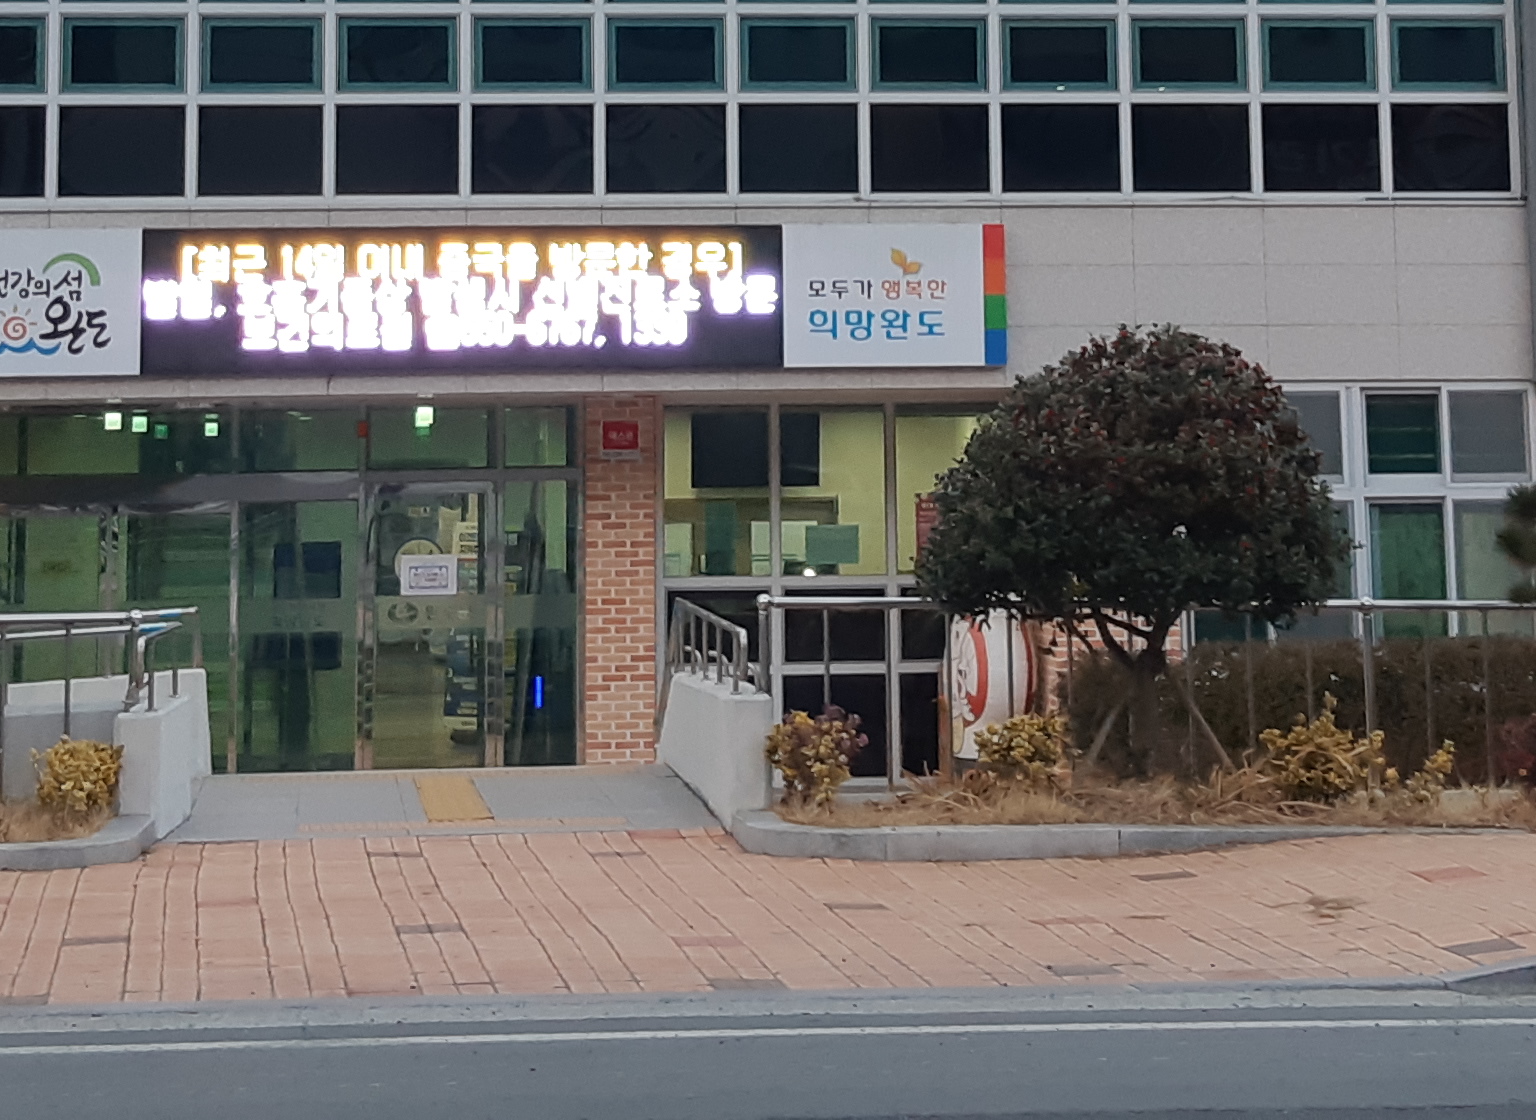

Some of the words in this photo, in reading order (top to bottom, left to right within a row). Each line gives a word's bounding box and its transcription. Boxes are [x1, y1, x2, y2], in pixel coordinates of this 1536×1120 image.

[53, 269, 82, 302] 섬
[808, 279, 873, 300] 모두가
[39, 295, 112, 355] 완도
